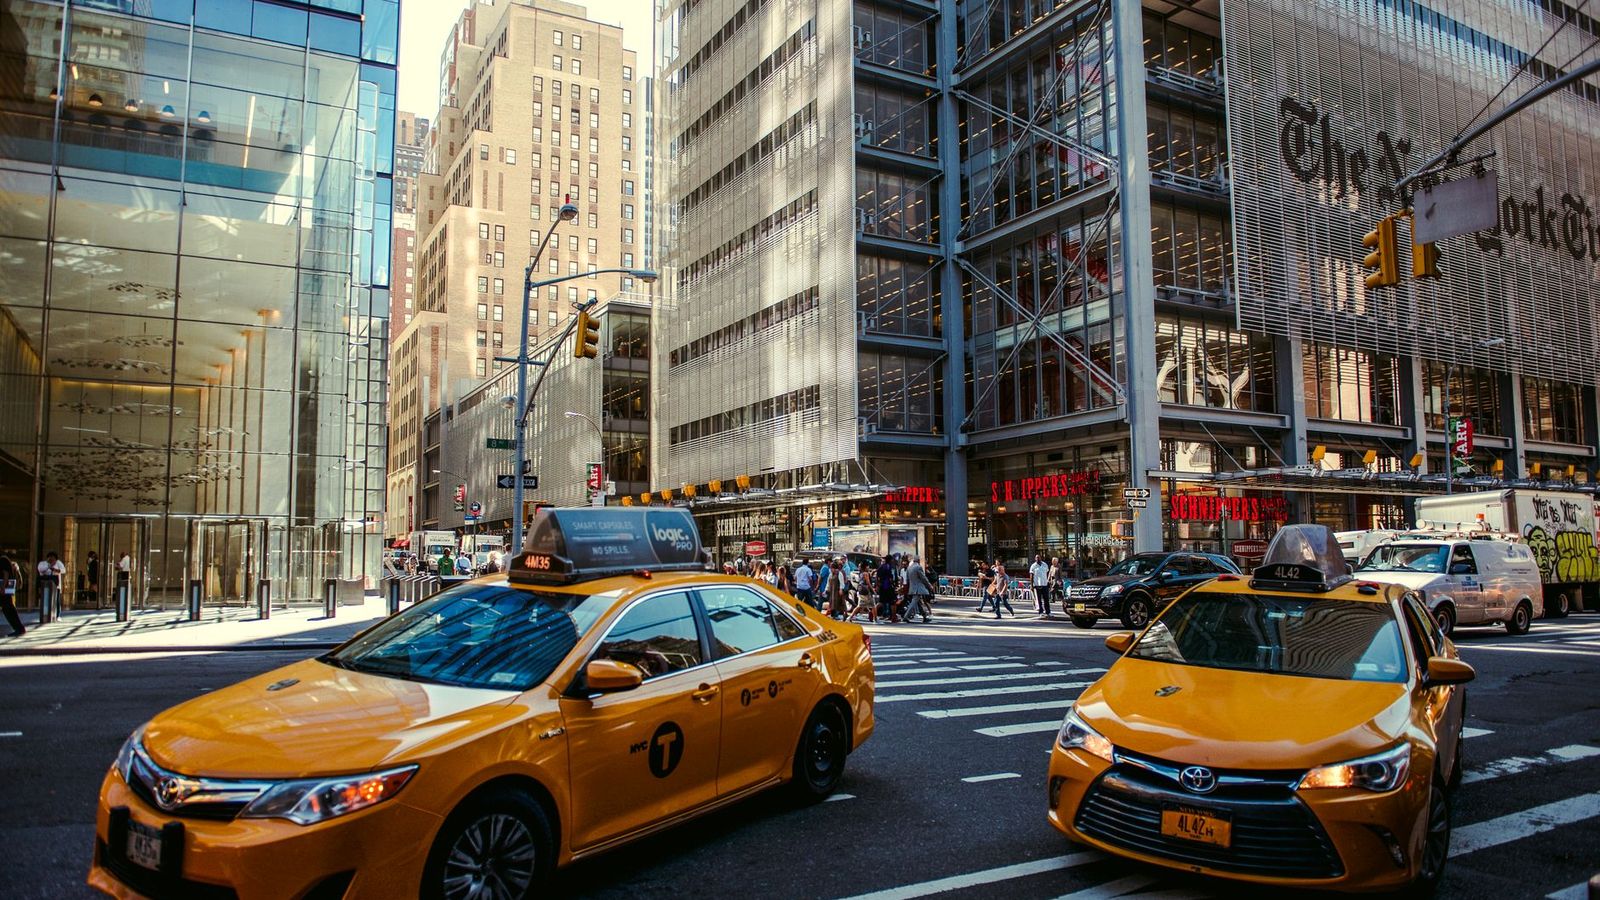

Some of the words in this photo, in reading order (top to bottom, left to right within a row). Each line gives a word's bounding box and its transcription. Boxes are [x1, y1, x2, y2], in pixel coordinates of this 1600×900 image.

[1281, 97, 1369, 200] The
[1475, 184, 1561, 258] ork
[1562, 192, 1600, 263] Ti
[572, 521, 598, 530] SMART
[592, 546, 603, 555] NO
[676, 541, 692, 551] PRO
[525, 555, 550, 570] 4M35
[1274, 566, 1300, 579] 4L42
[630, 741, 648, 754] NYC
[657, 731, 676, 771] T
